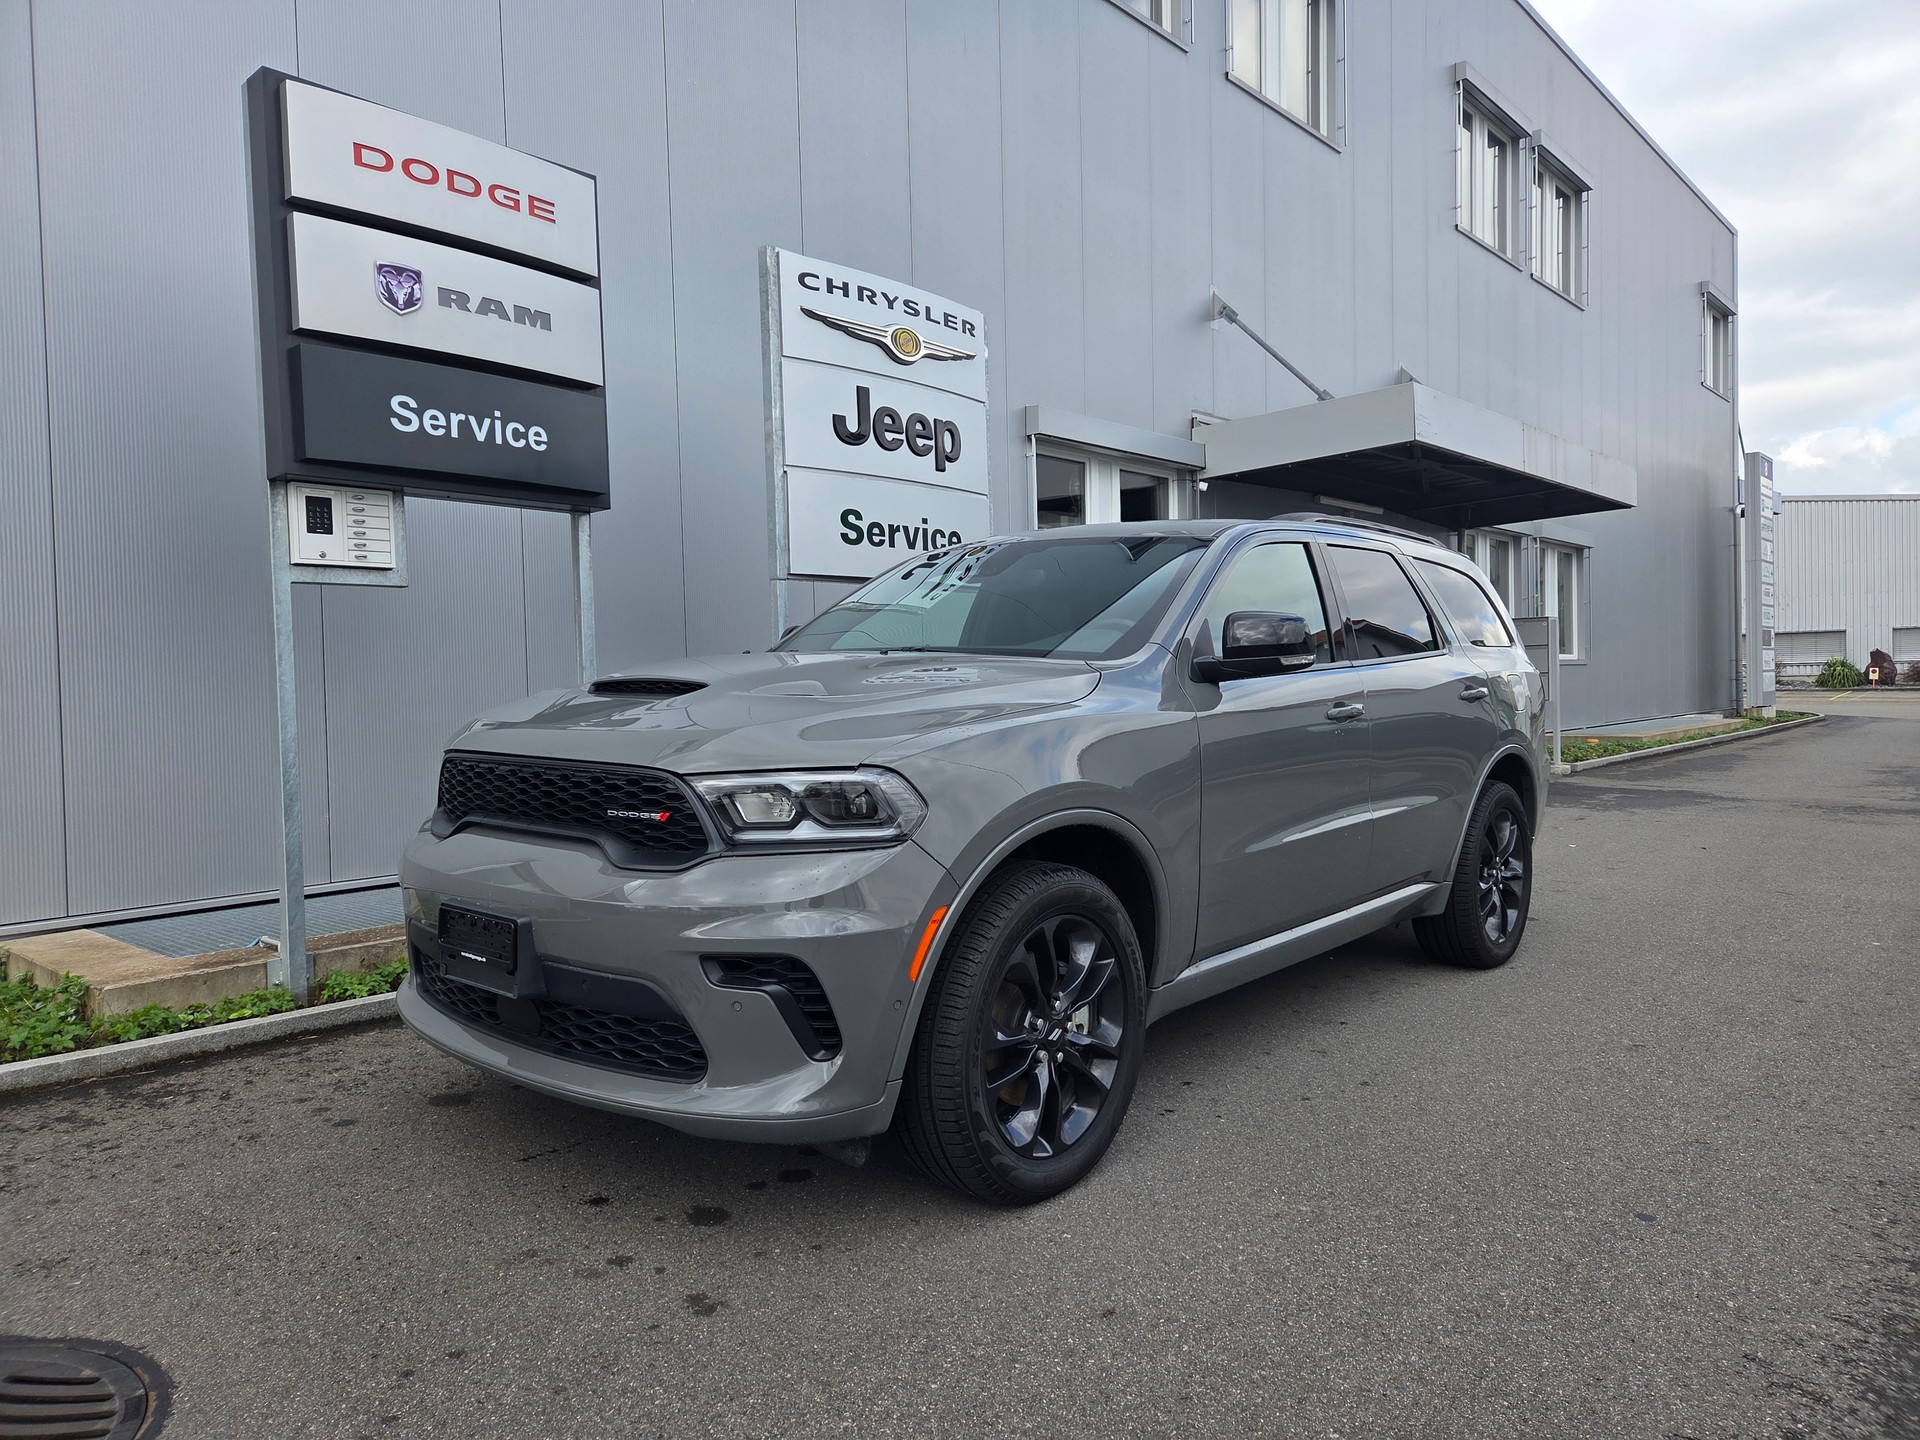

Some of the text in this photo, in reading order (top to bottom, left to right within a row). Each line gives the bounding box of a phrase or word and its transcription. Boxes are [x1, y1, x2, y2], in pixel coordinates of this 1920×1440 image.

[353, 142, 556, 224] DODGE
[437, 286, 552, 331] RAM
[798, 272, 976, 338] CHRYSLER
[390, 394, 548, 451] Service
[832, 385, 962, 472] Jeep
[840, 508, 962, 552] Service
[607, 809, 661, 820] DODGE
